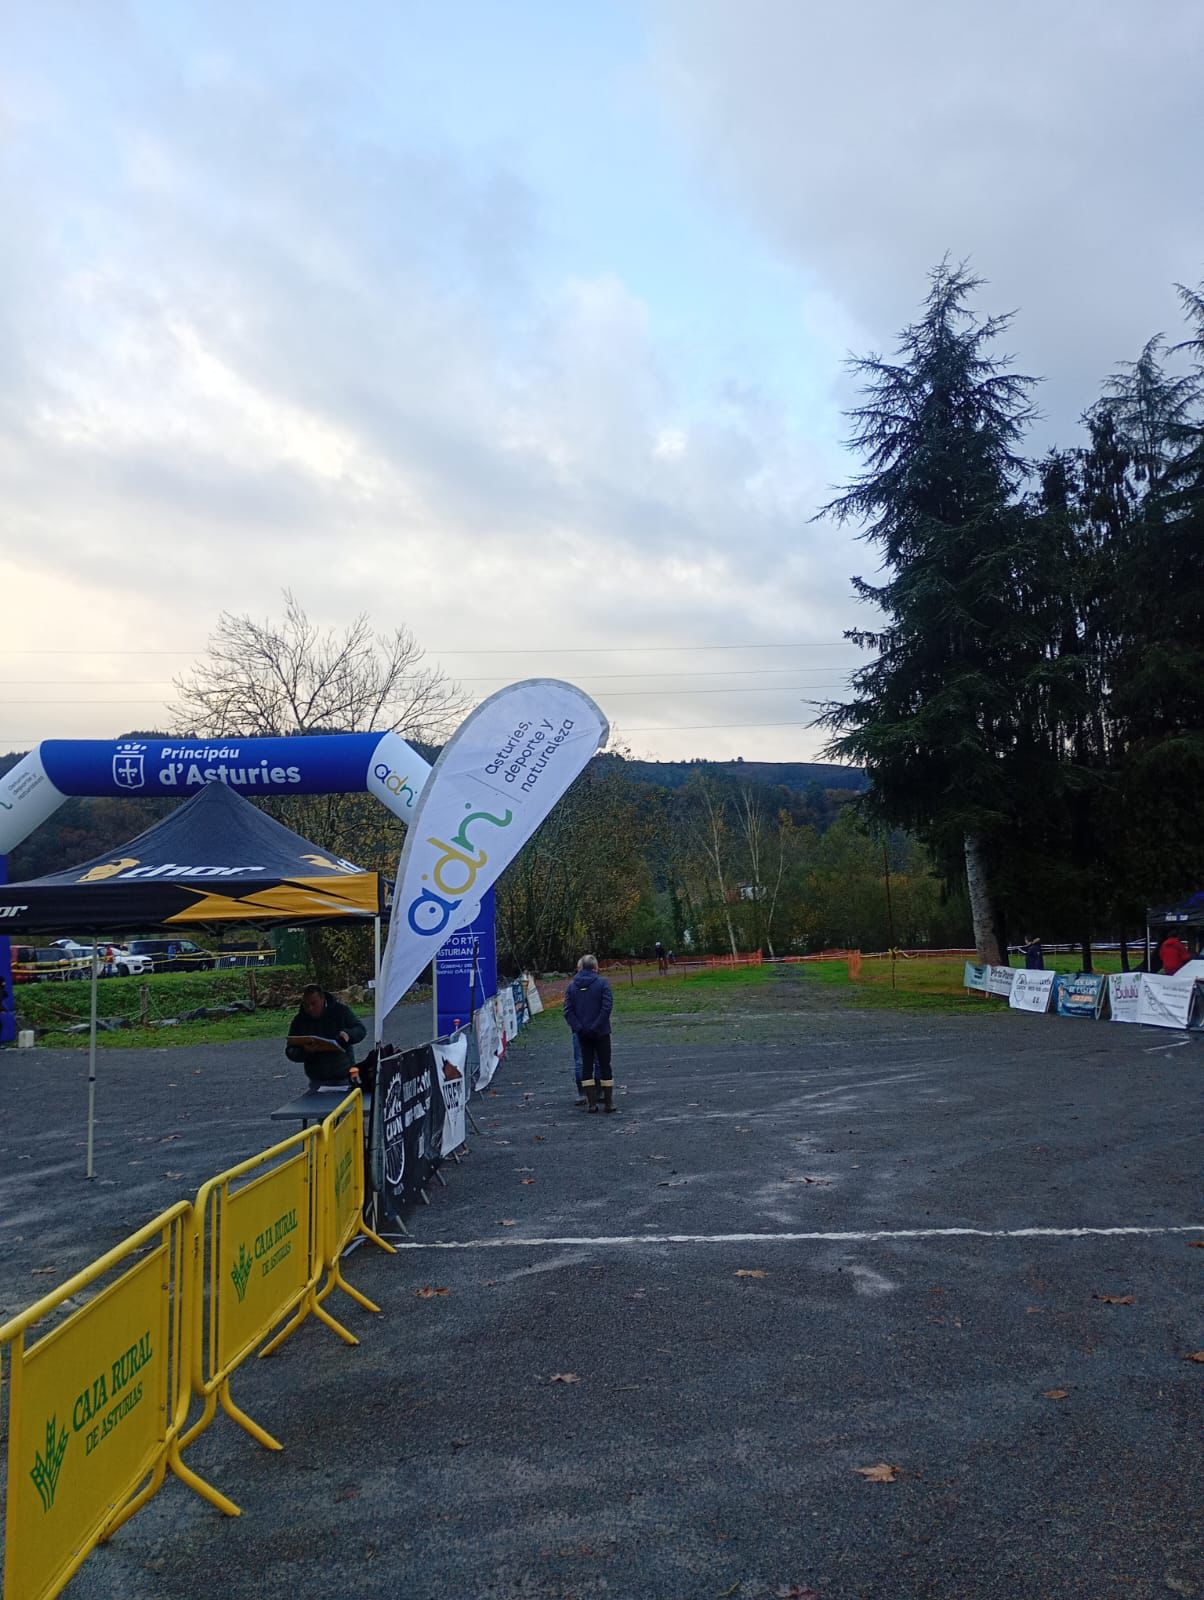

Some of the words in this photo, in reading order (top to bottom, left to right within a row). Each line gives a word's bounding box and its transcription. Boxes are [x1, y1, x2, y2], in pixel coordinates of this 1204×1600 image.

[160, 746, 240, 763] Principáu
[504, 731, 545, 783] deporte
[540, 718, 554, 731] y
[520, 719, 575, 793] naturaleza
[118, 863, 267, 879] thor
[254, 1225, 274, 1259] CAJA
[274, 1208, 299, 1244] RURAL
[262, 1261, 270, 1277] DE
[270, 1241, 291, 1274] ASTURIAS
[72, 1373, 108, 1432] CAJA
[111, 1330, 153, 1397] RURAL
[86, 1425, 100, 1456] DE
[101, 1381, 143, 1441] ASTURIAS
